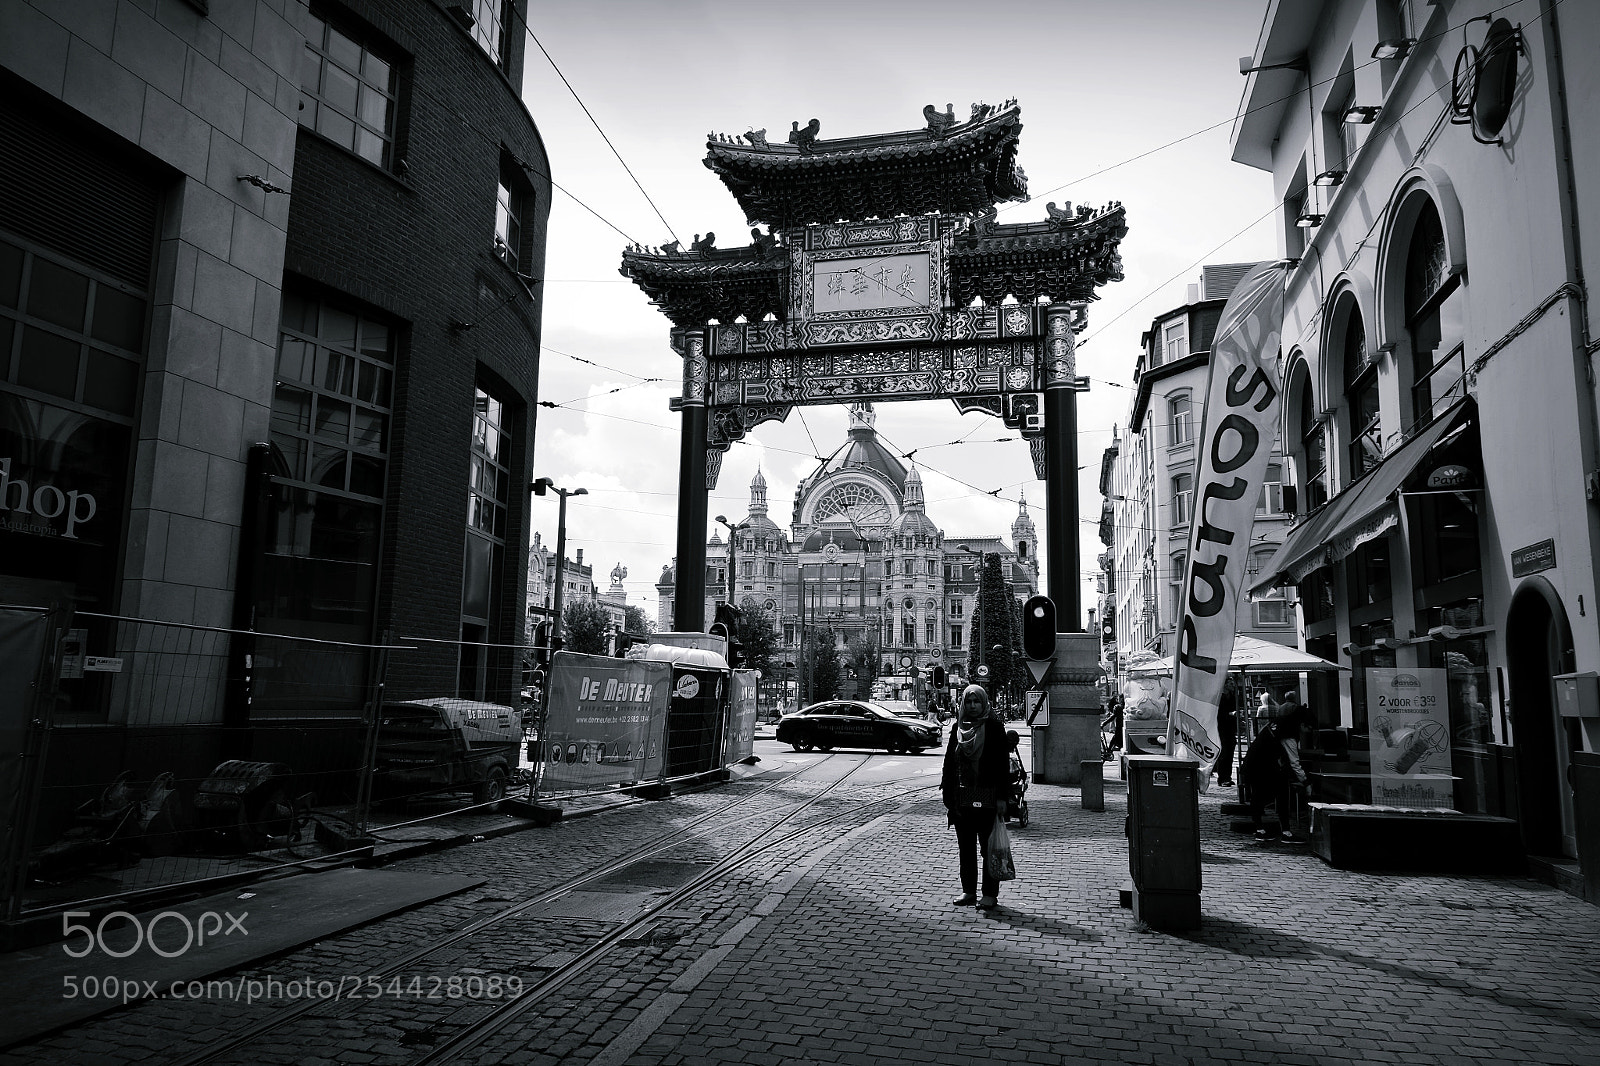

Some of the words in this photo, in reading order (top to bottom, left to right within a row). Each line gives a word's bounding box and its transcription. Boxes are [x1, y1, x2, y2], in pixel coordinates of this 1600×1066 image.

[1180, 363, 1277, 674] Panos
[1577, 594, 1586, 617] 1
[580, 676, 602, 702] DE
[604, 678, 653, 704] MEUTER
[1378, 695, 1386, 707] 2
